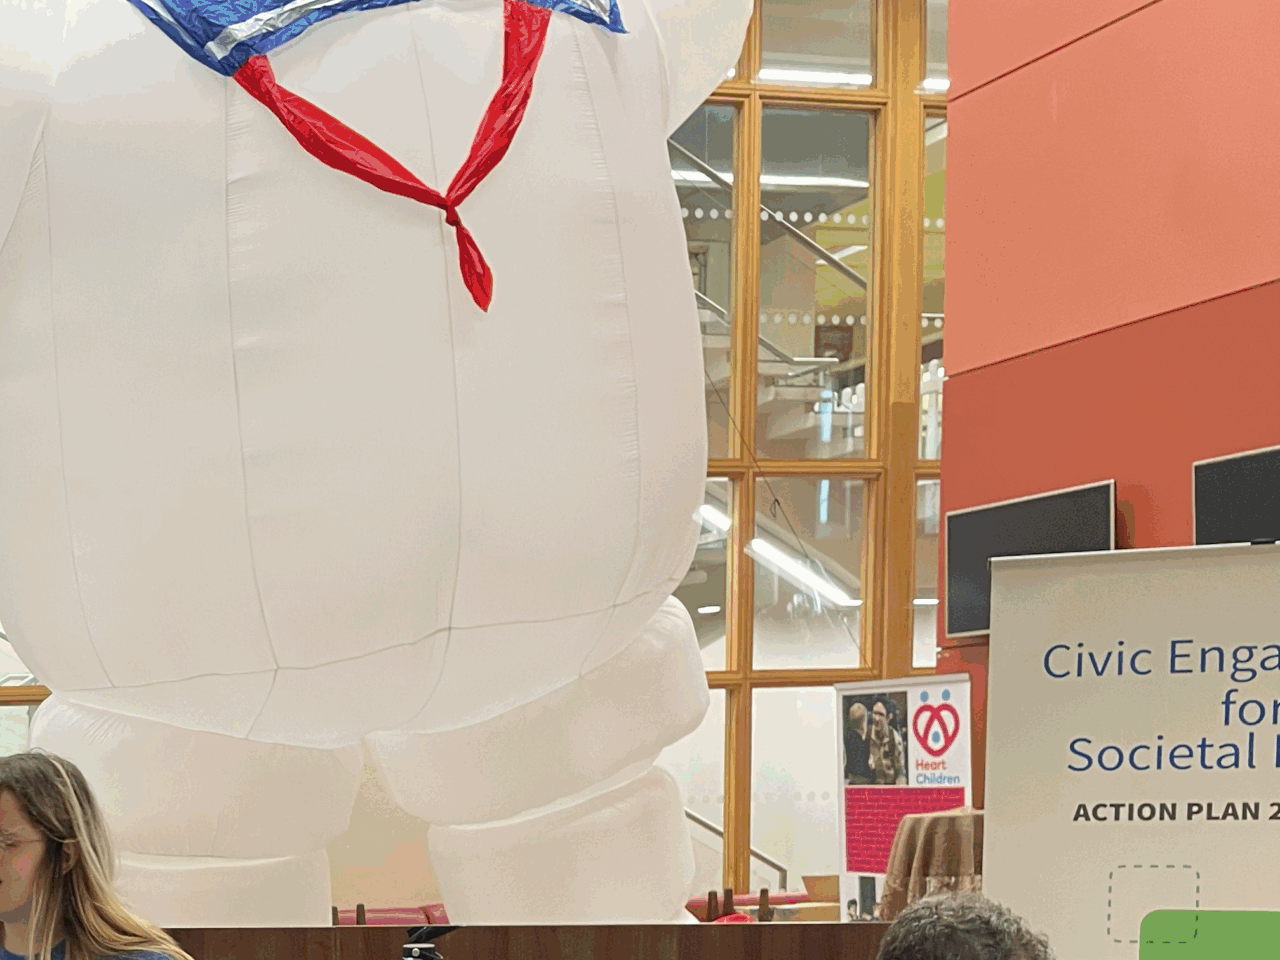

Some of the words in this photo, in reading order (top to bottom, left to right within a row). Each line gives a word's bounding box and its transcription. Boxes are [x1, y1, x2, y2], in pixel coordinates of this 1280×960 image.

[1043, 640, 1152, 679] Civic
[1067, 732, 1256, 771] Societal
[915, 759, 947, 770] Heart
[916, 772, 960, 784] Children
[1073, 802, 1177, 822] ACTION
[1186, 802, 1260, 821] PLAN
